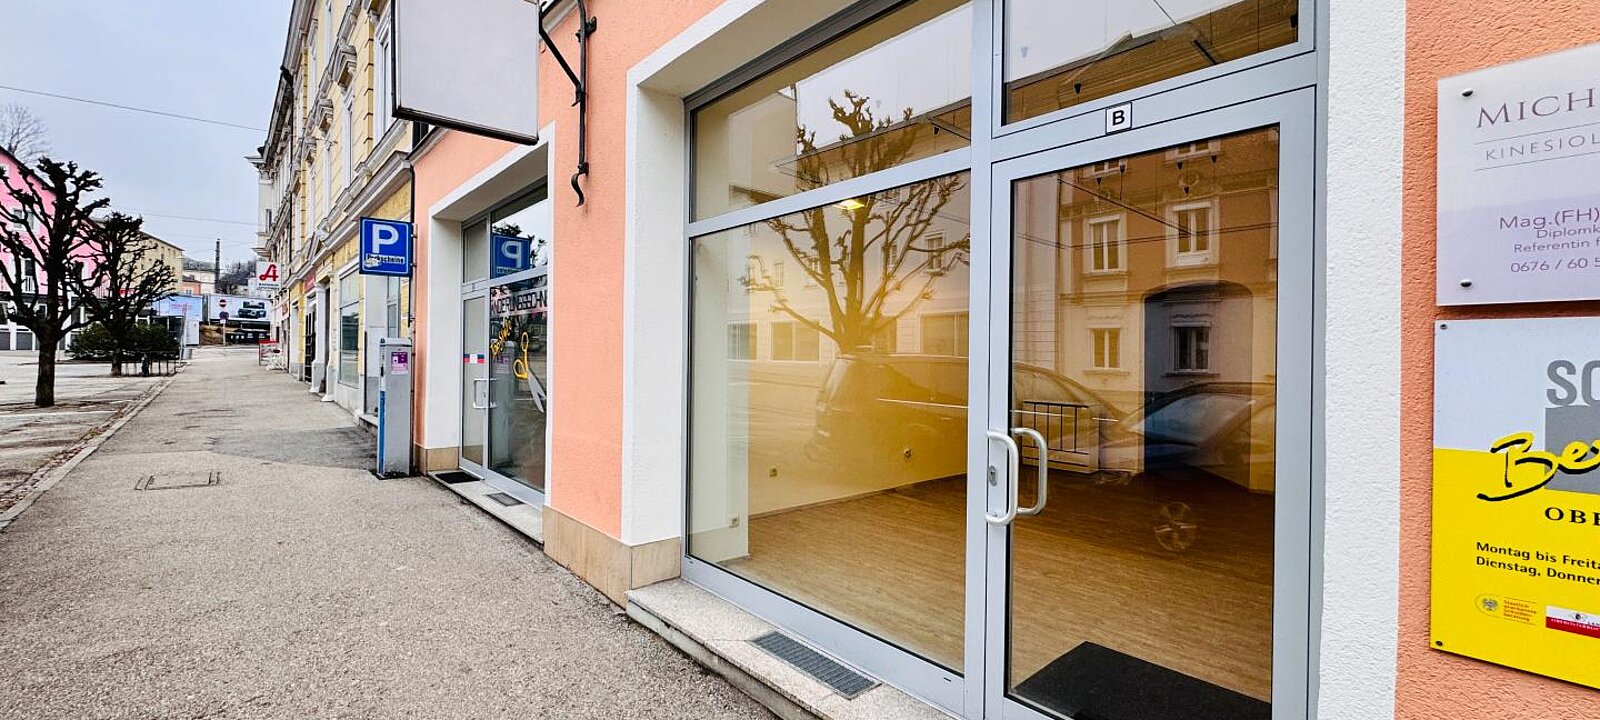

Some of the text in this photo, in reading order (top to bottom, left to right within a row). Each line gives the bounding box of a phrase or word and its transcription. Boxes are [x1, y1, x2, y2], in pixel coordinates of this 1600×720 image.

[1112, 110, 1125, 126] B
[1476, 87, 1596, 129] MICH
[1485, 133, 1600, 161] KINESIOL
[1500, 207, 1600, 230] Mag.(FH)
[371, 223, 399, 254] P
[1513, 240, 1590, 253] Referentin
[1510, 259, 1550, 273] 0676
[1567, 257, 1588, 269] 60
[1476, 541, 1530, 561] Montag
[1536, 550, 1557, 563] bis
